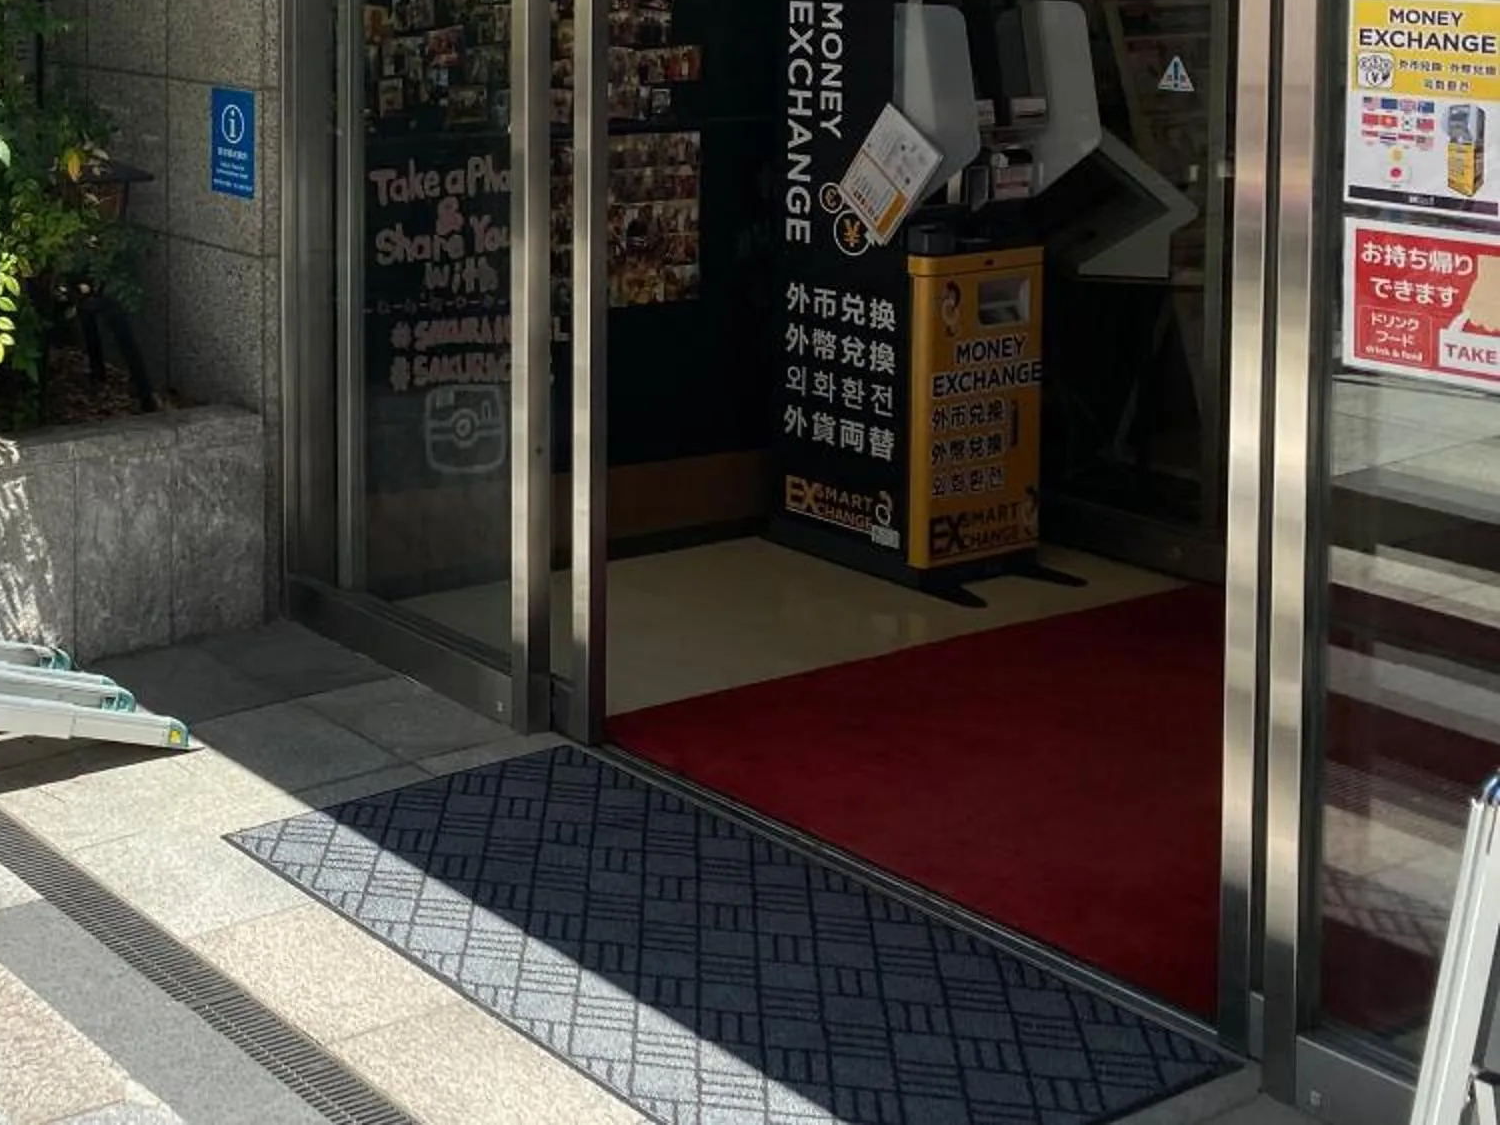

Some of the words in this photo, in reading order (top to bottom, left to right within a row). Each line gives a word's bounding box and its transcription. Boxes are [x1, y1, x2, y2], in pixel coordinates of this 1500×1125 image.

[1389, 8, 1464, 26] MONEY
[1359, 28, 1497, 54] EXCHANGE
[820, 2, 844, 140] MONEY
[785, 0, 815, 244] EXCHANGE
[369, 158, 440, 206] Take
[376, 223, 465, 266] Share
[1361, 242, 1474, 276] お持ち帰り
[1369, 277, 1460, 307] できます
[1370, 312, 1420, 332] ドリンク
[1376, 331, 1416, 347] フード
[956, 336, 1026, 364] MONEY
[1444, 343, 1498, 365] TAKE
[785, 365, 894, 418] 외화환전
[932, 361, 1043, 398] EXCHANGE
[783, 405, 895, 463] 外貨両替
